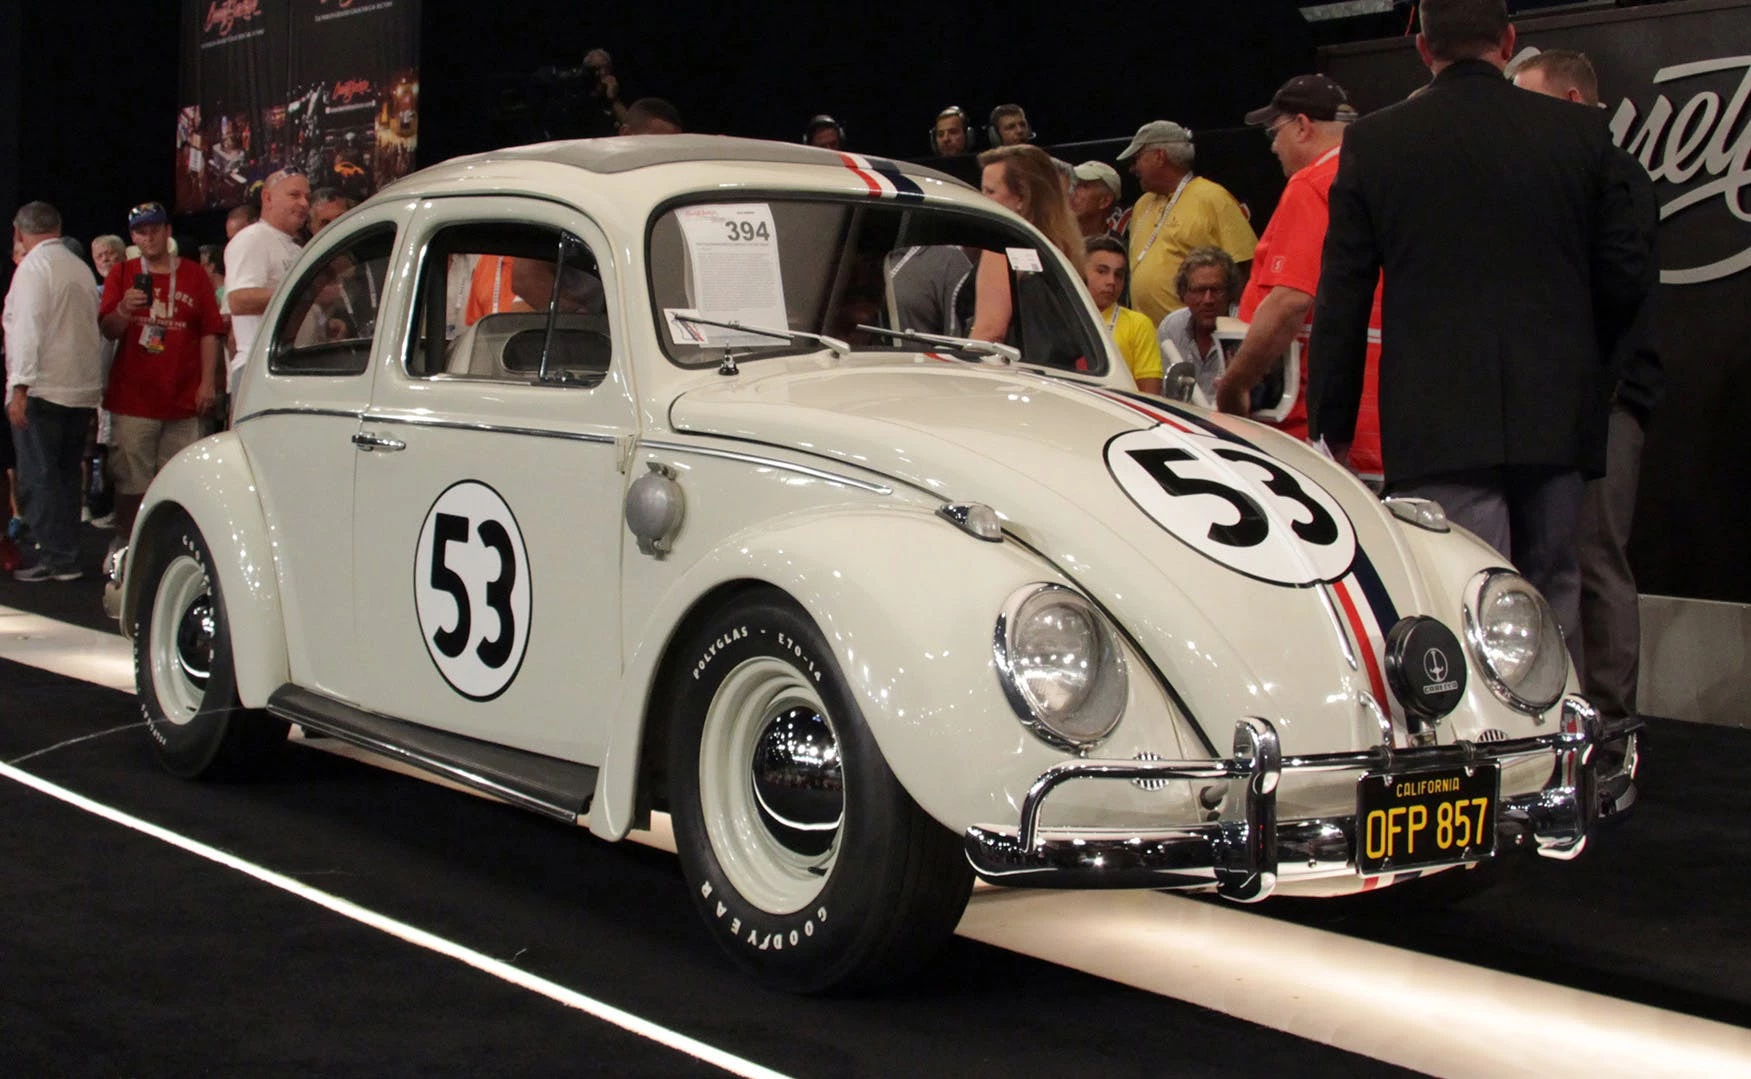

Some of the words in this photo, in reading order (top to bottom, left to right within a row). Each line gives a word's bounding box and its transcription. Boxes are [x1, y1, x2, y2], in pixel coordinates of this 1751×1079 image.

[725, 220, 770, 241] 394
[1125, 447, 1339, 548] 53
[430, 512, 517, 669] 53
[692, 626, 749, 680] POLYGLAS
[778, 632, 822, 682] E70-14
[1396, 776, 1460, 798] CALIFORNIA
[1366, 805, 1428, 860] OFP
[1436, 797, 1489, 850] 857
[701, 880, 828, 950] GOODYEAR
